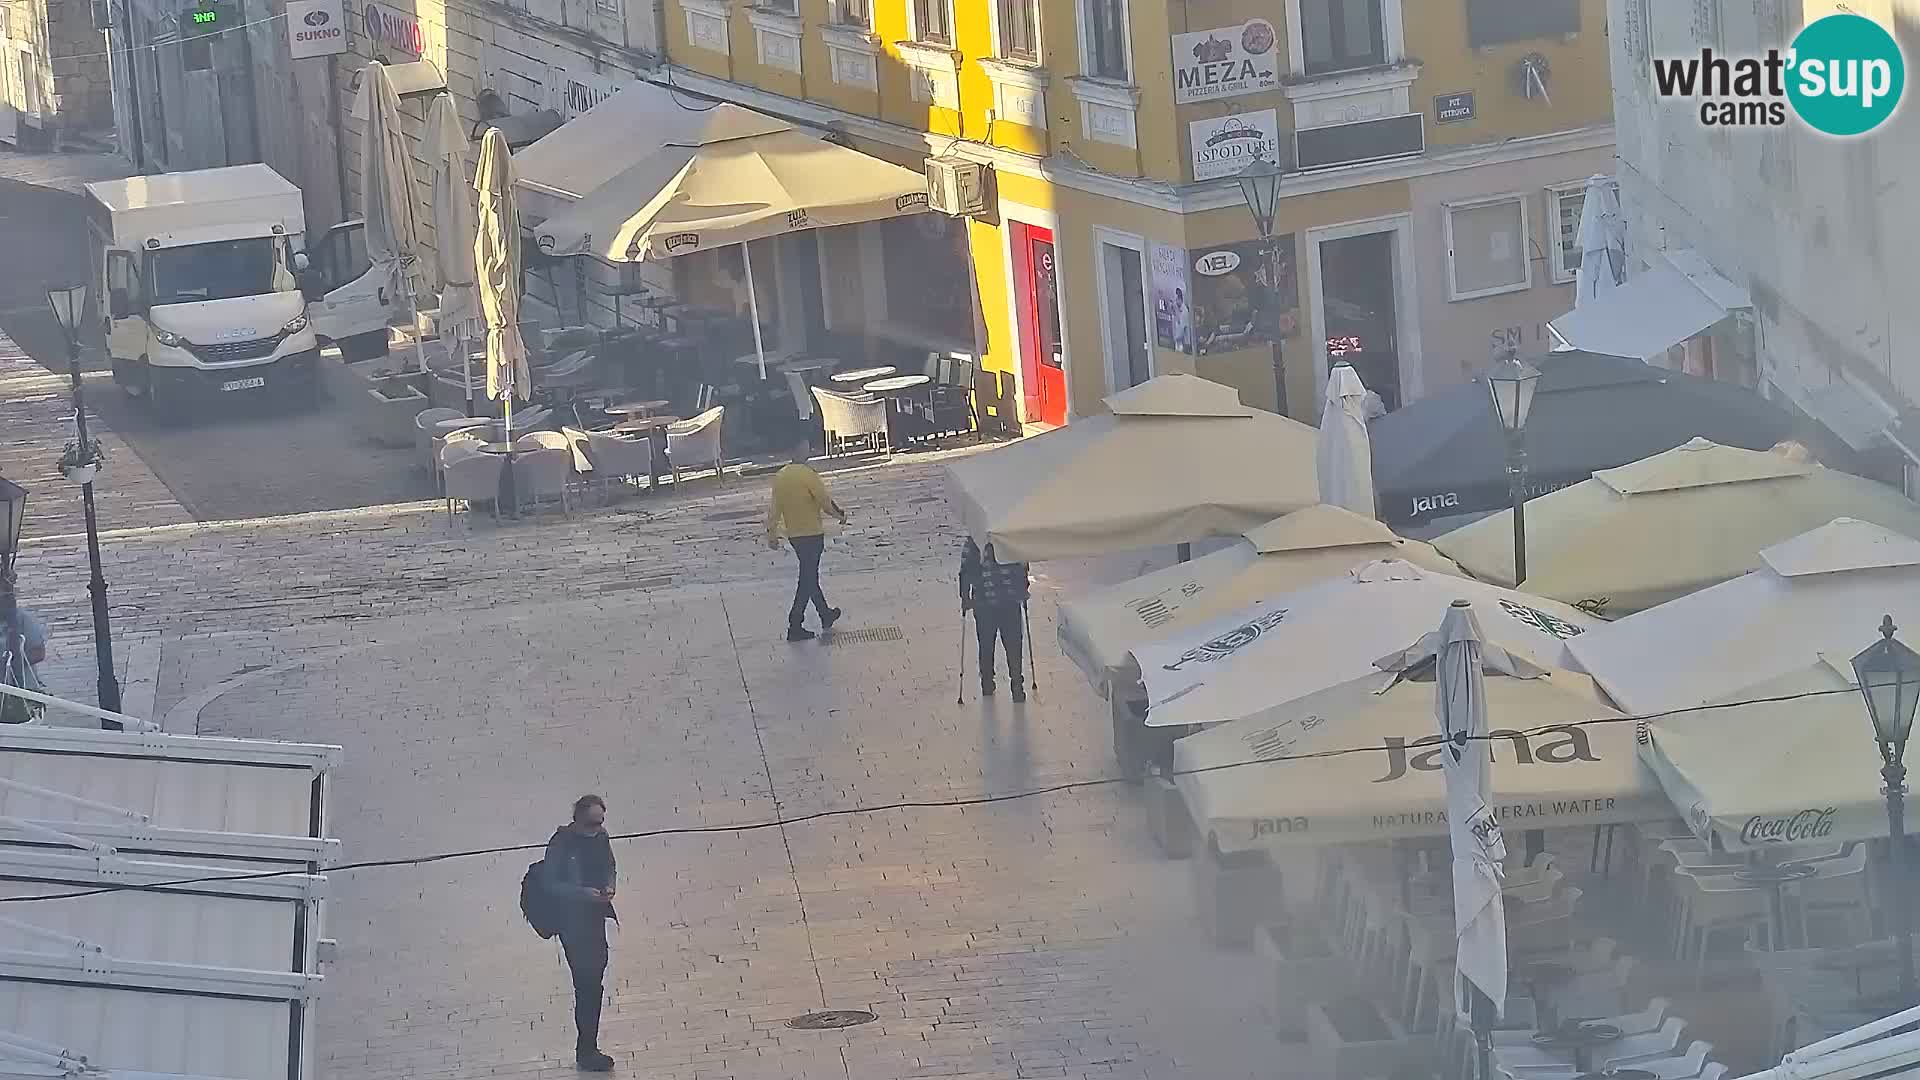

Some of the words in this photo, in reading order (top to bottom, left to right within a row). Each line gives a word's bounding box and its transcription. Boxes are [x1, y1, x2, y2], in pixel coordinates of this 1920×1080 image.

[296, 27, 341, 42] SUKNO
[382, 13, 426, 54] SUKNO
[1178, 58, 1257, 89] MEZA
[1187, 85, 1220, 97] PIZZERIA
[1227, 80, 1249, 92] GRILL
[1197, 144, 1242, 163] ISPOD
[1372, 811, 1449, 826] NATURA
[1552, 797, 1616, 816] WATER
